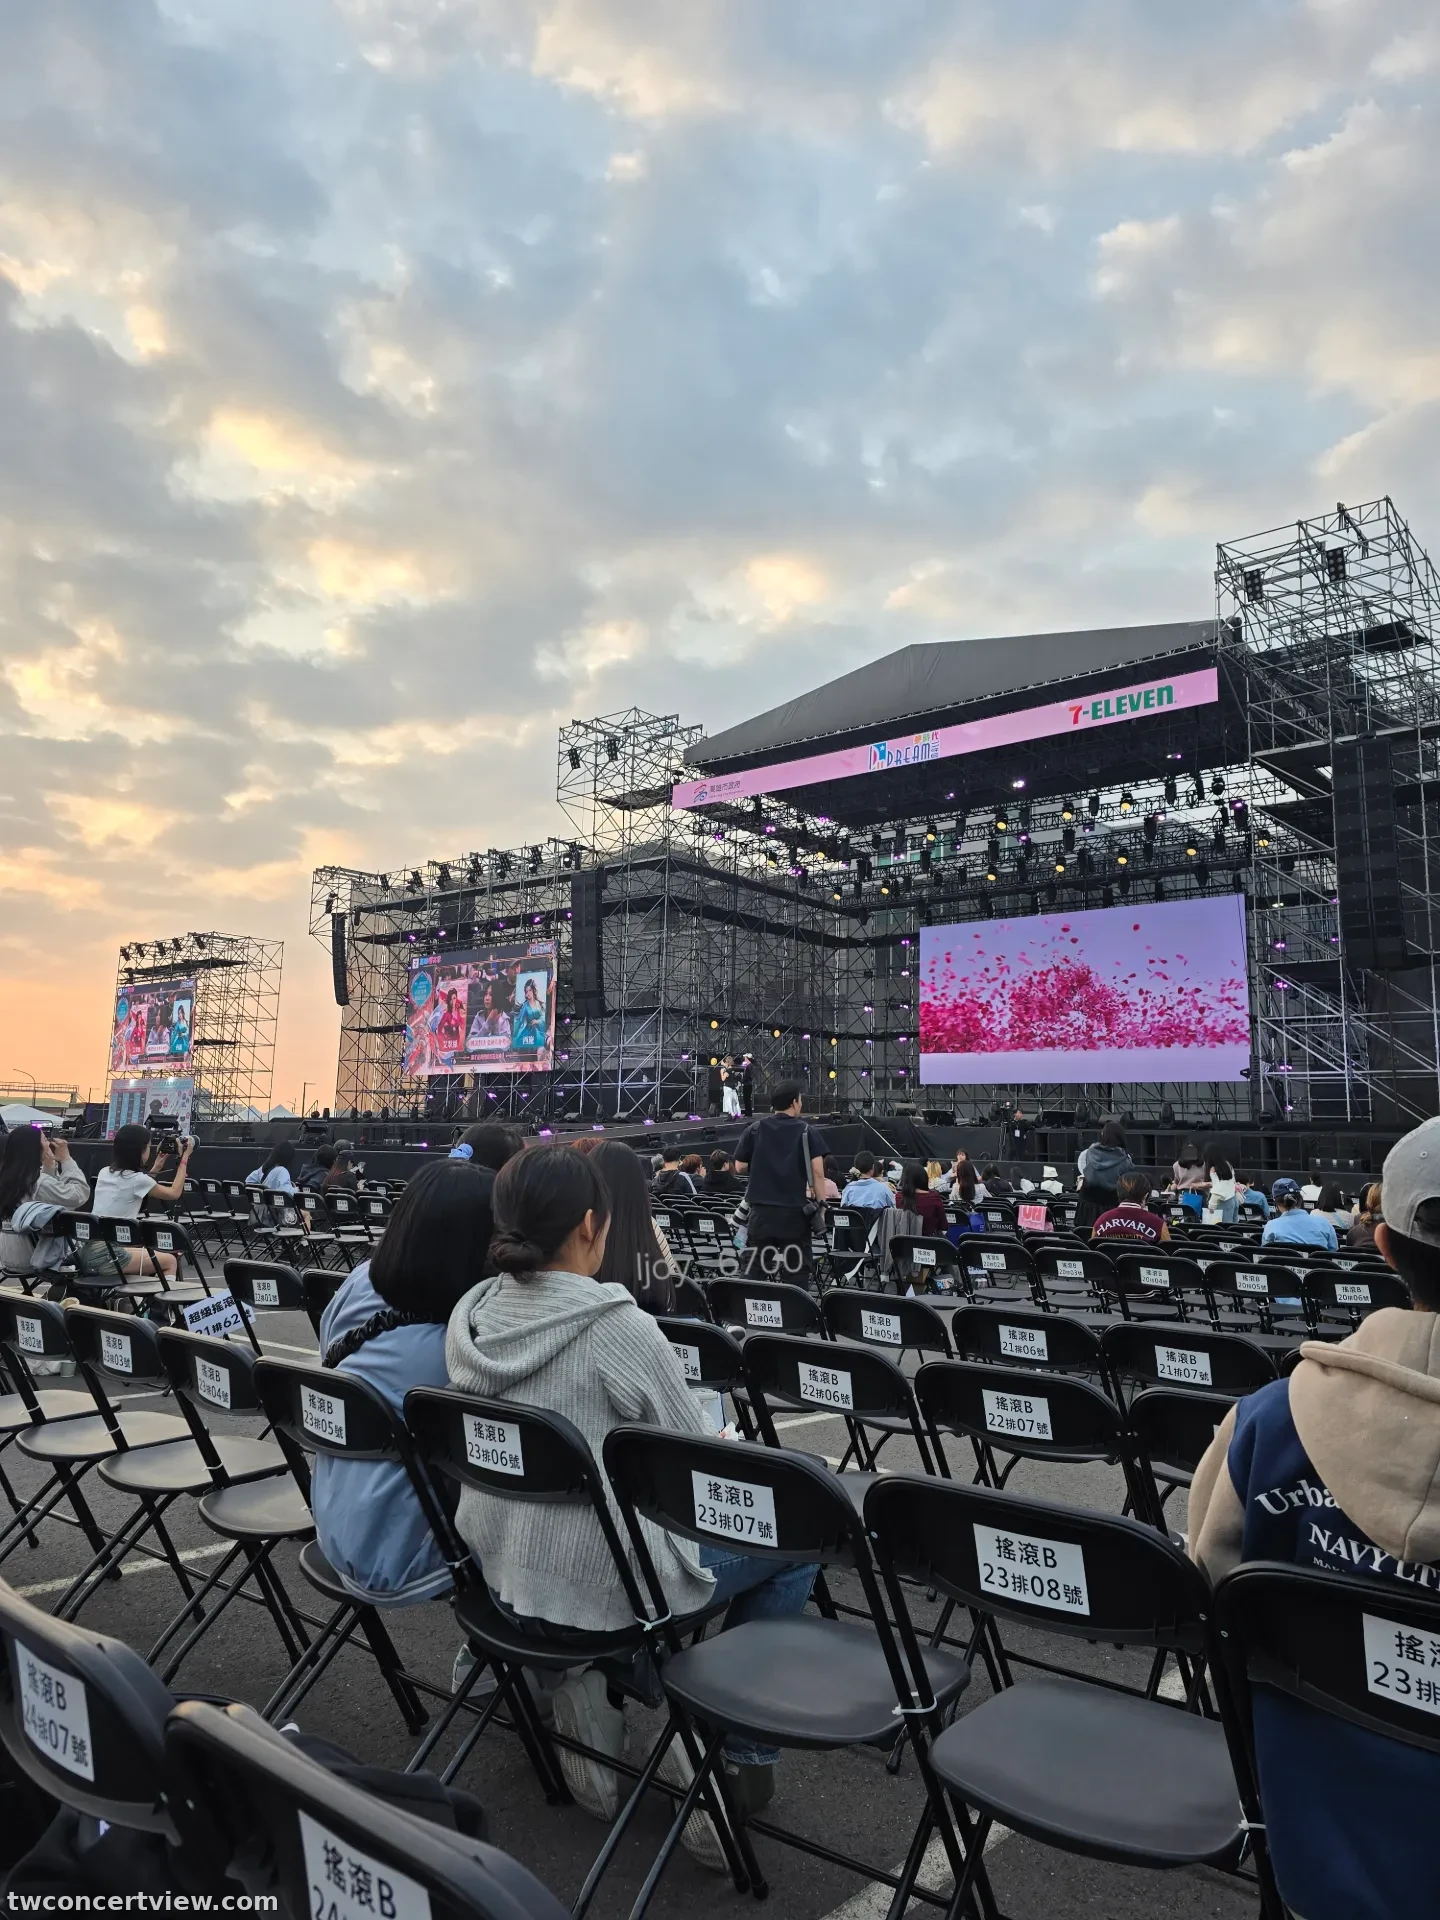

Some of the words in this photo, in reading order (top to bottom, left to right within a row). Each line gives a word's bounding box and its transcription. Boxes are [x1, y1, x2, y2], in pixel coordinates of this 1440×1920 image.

[887, 742, 931, 767] DREAM
[1096, 1218, 1157, 1239] HARVARD
[188, 1295, 236, 1324] 超級搖滾
[751, 1302, 773, 1312] 搖滾B
[748, 1313, 781, 1325] 21排04號
[868, 1314, 892, 1327] 搖滾B
[105, 1335, 123, 1350] 搖滾B
[863, 1326, 900, 1341] 21排05號
[1008, 1329, 1035, 1342] 搖滾B
[672, 1345, 689, 1359] 滾B
[1002, 1341, 1046, 1358] 21排06號
[1166, 1350, 1197, 1365] 搖滾B
[103, 1353, 131, 1369] 23排03號
[201, 1364, 221, 1382] 搖滾B
[808, 1368, 839, 1386] 搖滾B
[1159, 1363, 1210, 1382] 21排07號
[199, 1378, 229, 1404] 23排04號
[802, 1383, 851, 1405] 22排06號
[308, 1393, 333, 1415] 搖滾B
[995, 1395, 1033, 1414] 搖滾B
[303, 1409, 344, 1440] 23排05號
[473, 1420, 506, 1443] 搖滾B
[988, 1412, 1049, 1435] 22排07號
[467, 1441, 521, 1470] 23排06號
[707, 1480, 755, 1508] 搖滾B
[697, 1503, 774, 1540] 23排07號
[995, 1535, 1058, 1569] 搖滾B
[1308, 1521, 1391, 1573] NAVY
[1394, 1558, 1440, 1593] LT
[983, 1562, 1084, 1606] 23排08號
[27, 1659, 67, 1711] 搖滾B
[23, 1694, 89, 1768] 24排07號
[322, 1840, 397, 1920] 搖滾B
